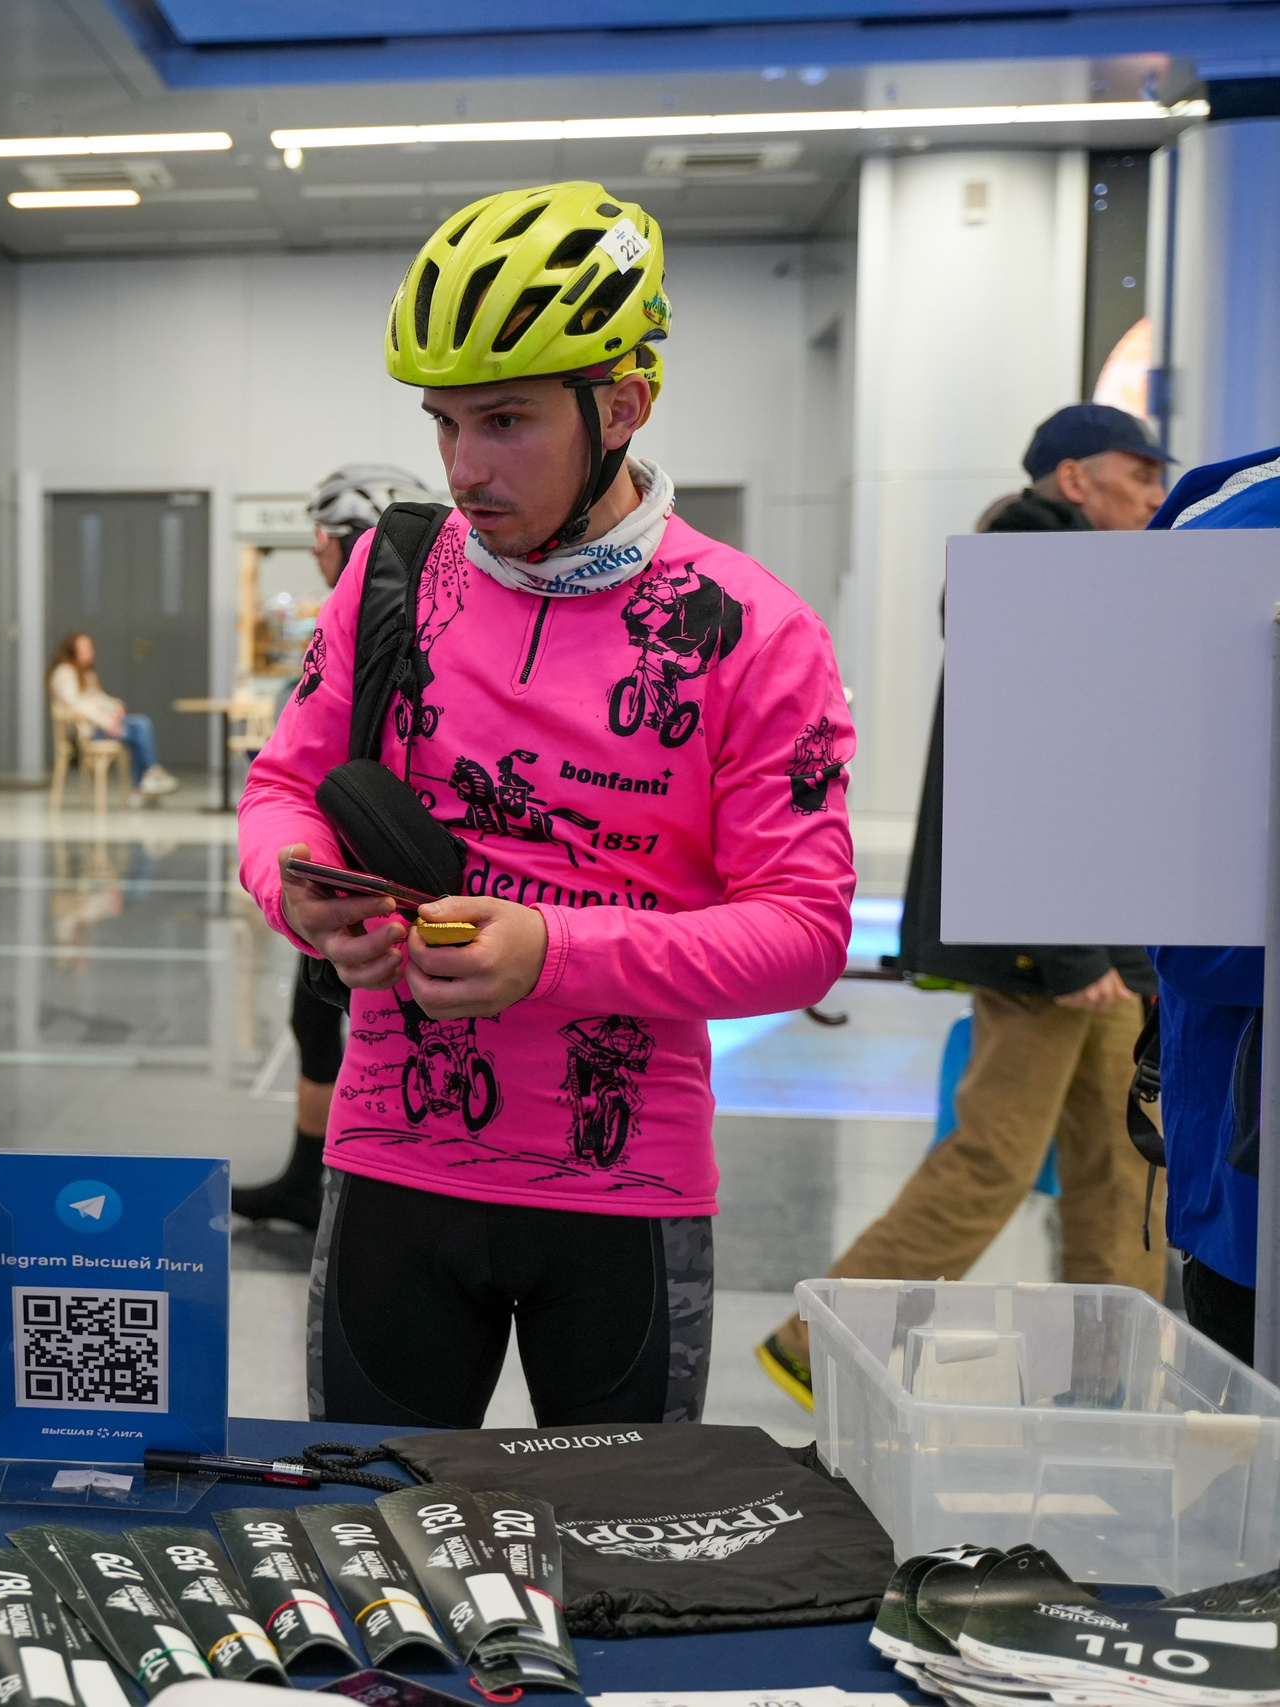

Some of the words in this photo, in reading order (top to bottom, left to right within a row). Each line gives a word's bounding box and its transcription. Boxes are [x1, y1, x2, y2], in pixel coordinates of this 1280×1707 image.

[620, 234, 644, 263] 221
[559, 760, 670, 796] bonfanti
[591, 832, 660, 854] 1857
[72, 1254, 151, 1270] Высшей
[155, 1257, 205, 1273] Лиги
[41, 1427, 95, 1437] ВЫСШАЯ
[111, 1430, 143, 1439] ЛИГА
[499, 1429, 644, 1455] ВЕЛОГОНКА
[417, 1502, 467, 1535] 130
[492, 1509, 537, 1539] 120
[557, 1518, 616, 1528] РУССКИ
[624, 1513, 678, 1524] ПОЛЯНА
[680, 1505, 739, 1521] КРАСНАЯ
[243, 1521, 293, 1548] 146
[330, 1522, 380, 1547] 110
[90, 1551, 145, 1581] 179
[165, 1545, 220, 1573] 159
[274, 1608, 301, 1640] 146
[365, 1608, 393, 1638] 110
[448, 1600, 475, 1633] 130
[1037, 1602, 1130, 1632] ТРИГОРЫ
[1075, 1633, 1211, 1675] 110
